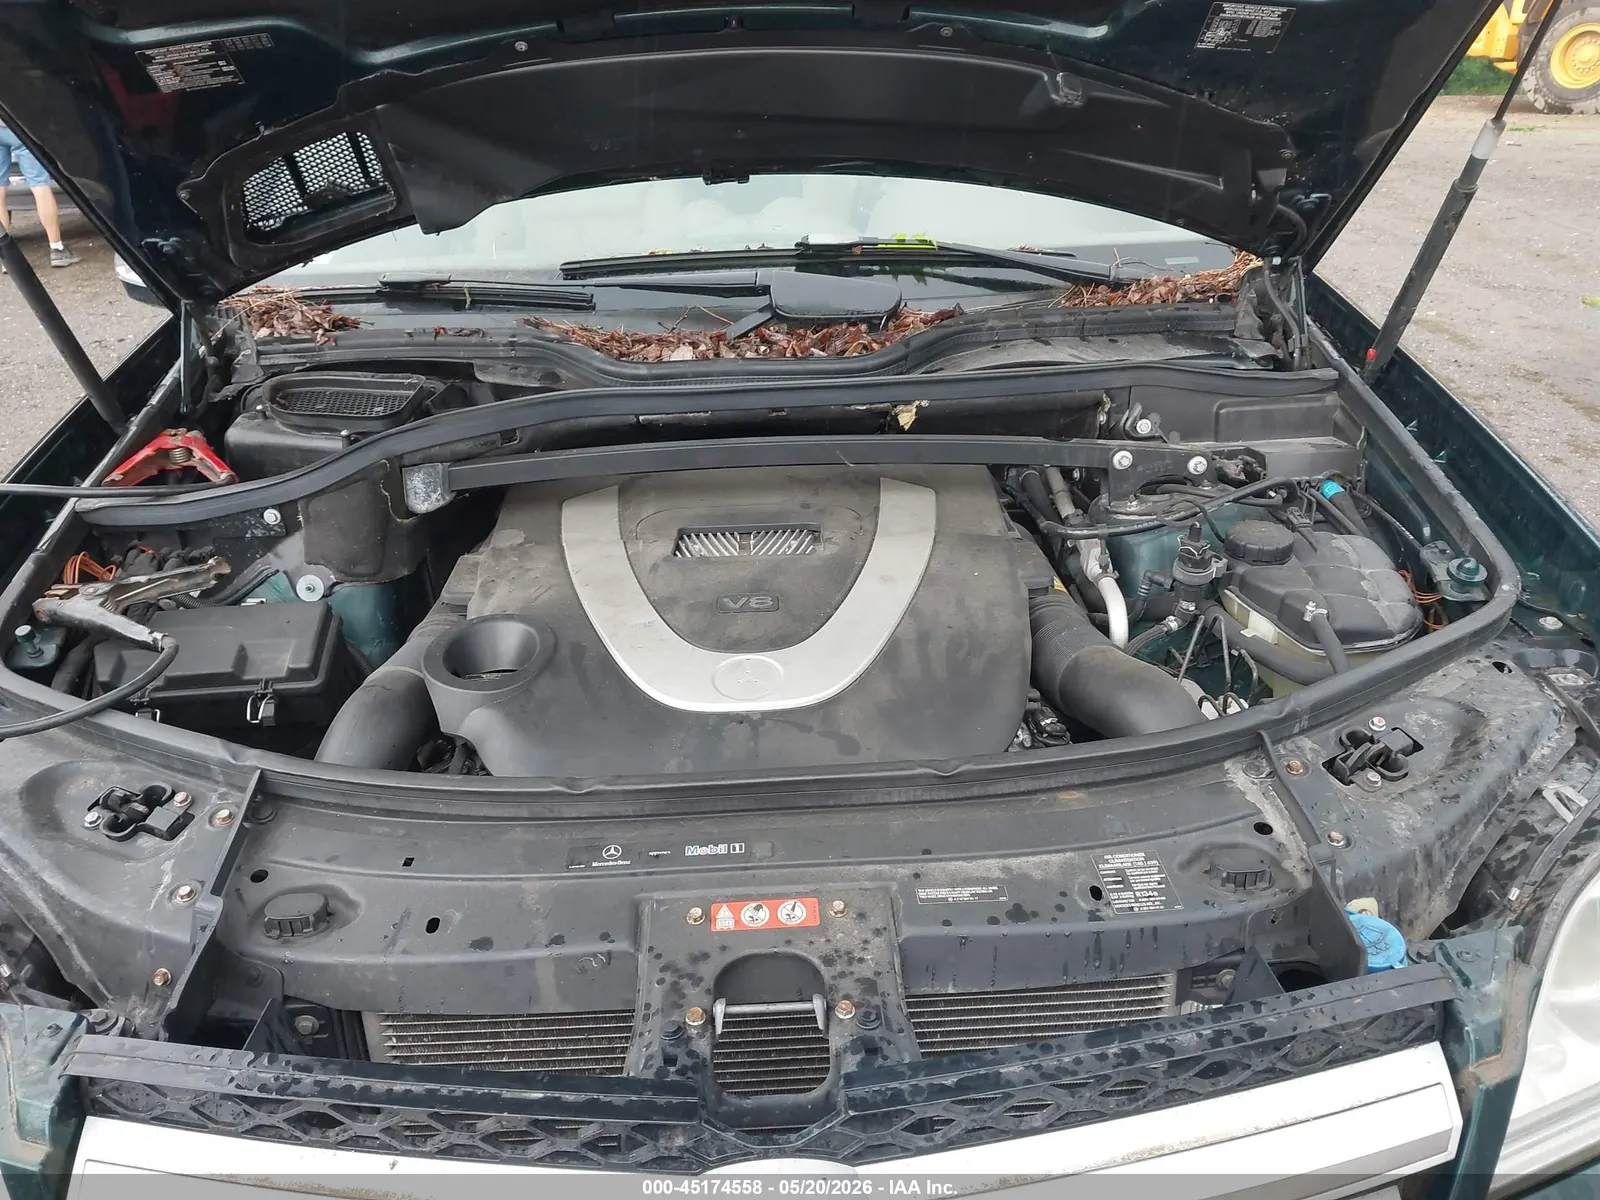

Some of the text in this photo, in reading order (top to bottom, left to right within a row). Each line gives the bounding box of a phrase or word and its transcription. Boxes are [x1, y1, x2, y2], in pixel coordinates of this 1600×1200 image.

[723, 596, 773, 608] V8
[685, 844, 728, 856] Mobil
[1135, 890, 1158, 898] R134a
